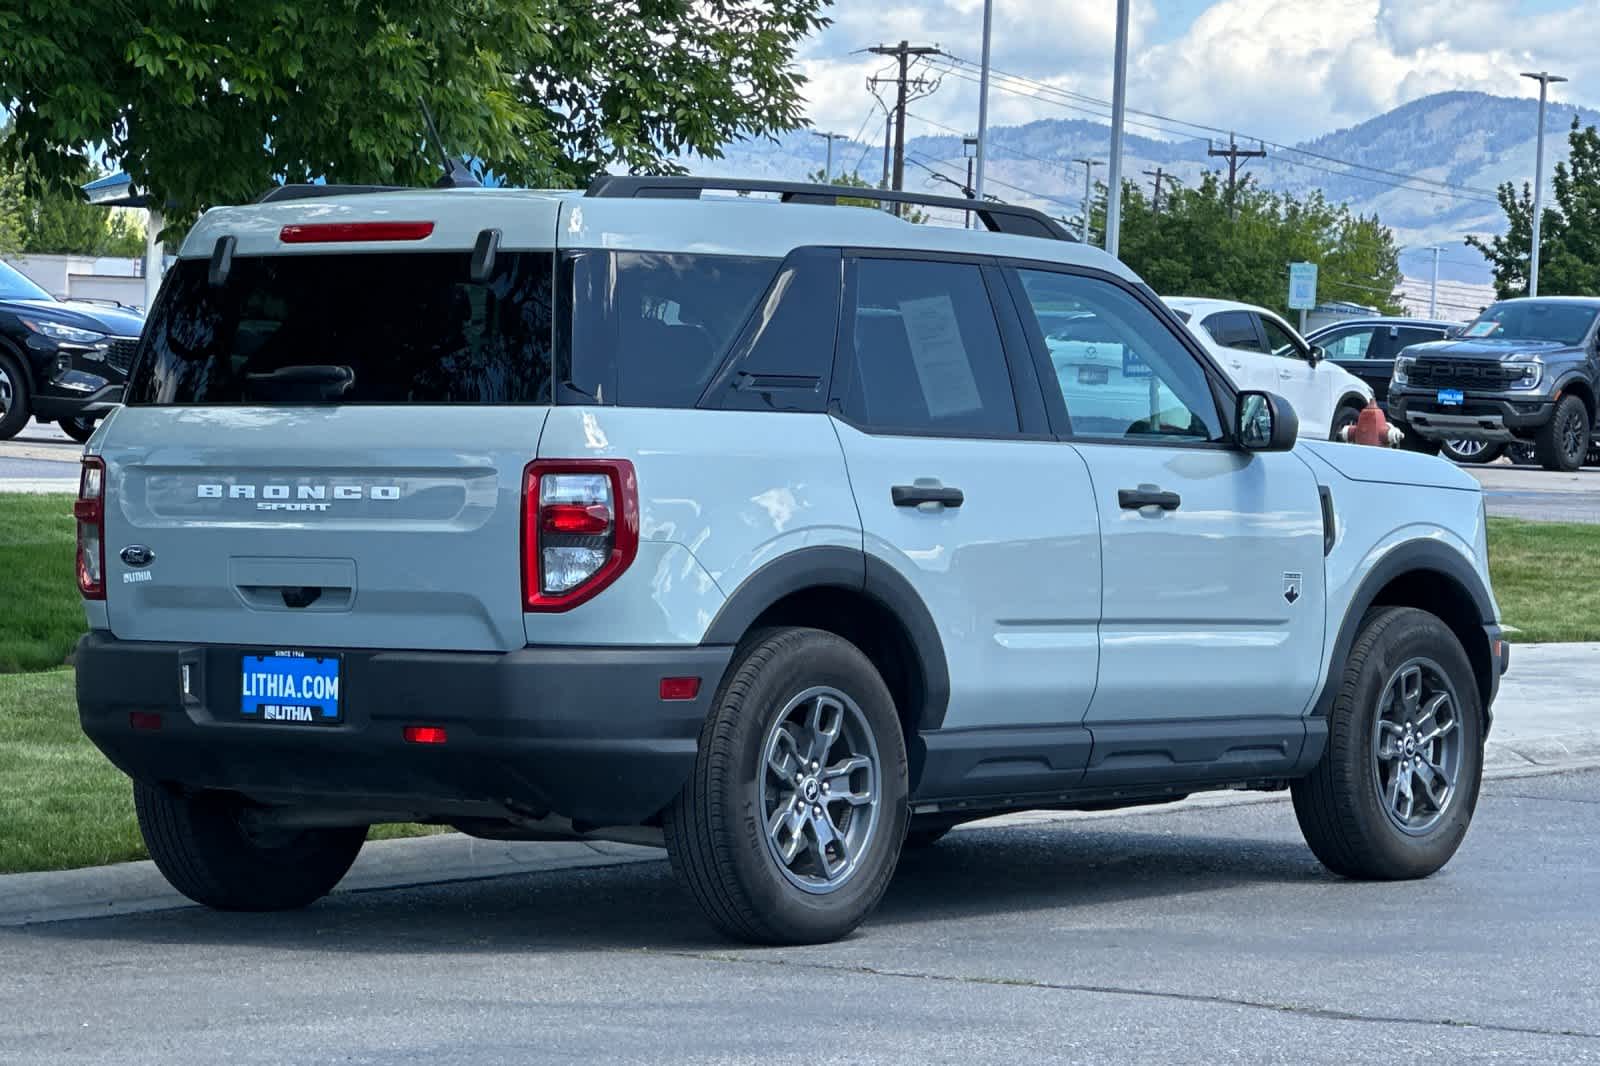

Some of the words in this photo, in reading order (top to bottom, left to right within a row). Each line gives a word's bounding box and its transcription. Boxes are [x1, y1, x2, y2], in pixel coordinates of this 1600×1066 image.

[197, 484, 400, 500] BRONCO
[256, 502, 331, 511] SPORT
[274, 650, 291, 658] SINCE
[242, 672, 339, 701] LITHIA.COM
[276, 705, 313, 721] LITHIA
